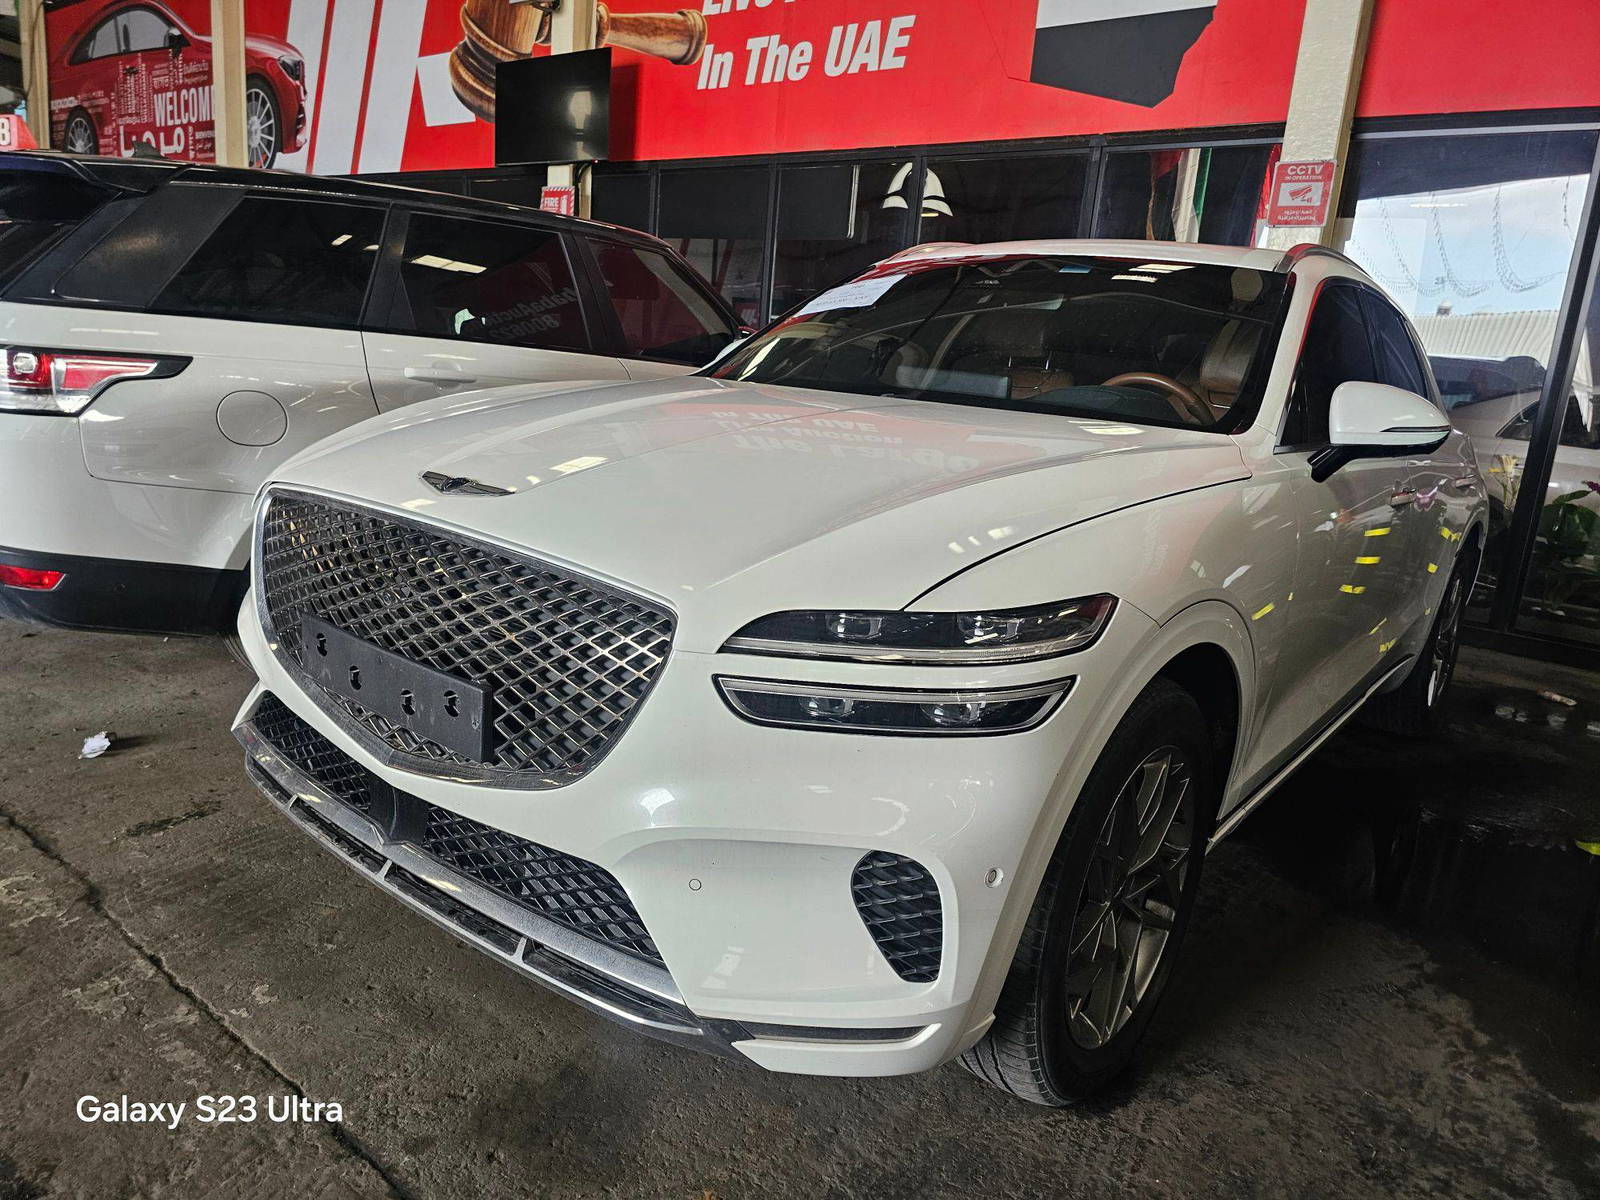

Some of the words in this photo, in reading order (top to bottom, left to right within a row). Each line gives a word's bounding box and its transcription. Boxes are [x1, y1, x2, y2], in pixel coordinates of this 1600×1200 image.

[697, 44, 734, 90] In
[745, 35, 814, 86] The
[824, 15, 917, 77] UAE
[1287, 165, 1324, 175] CCTV
[544, 197, 560, 208] FIRE
